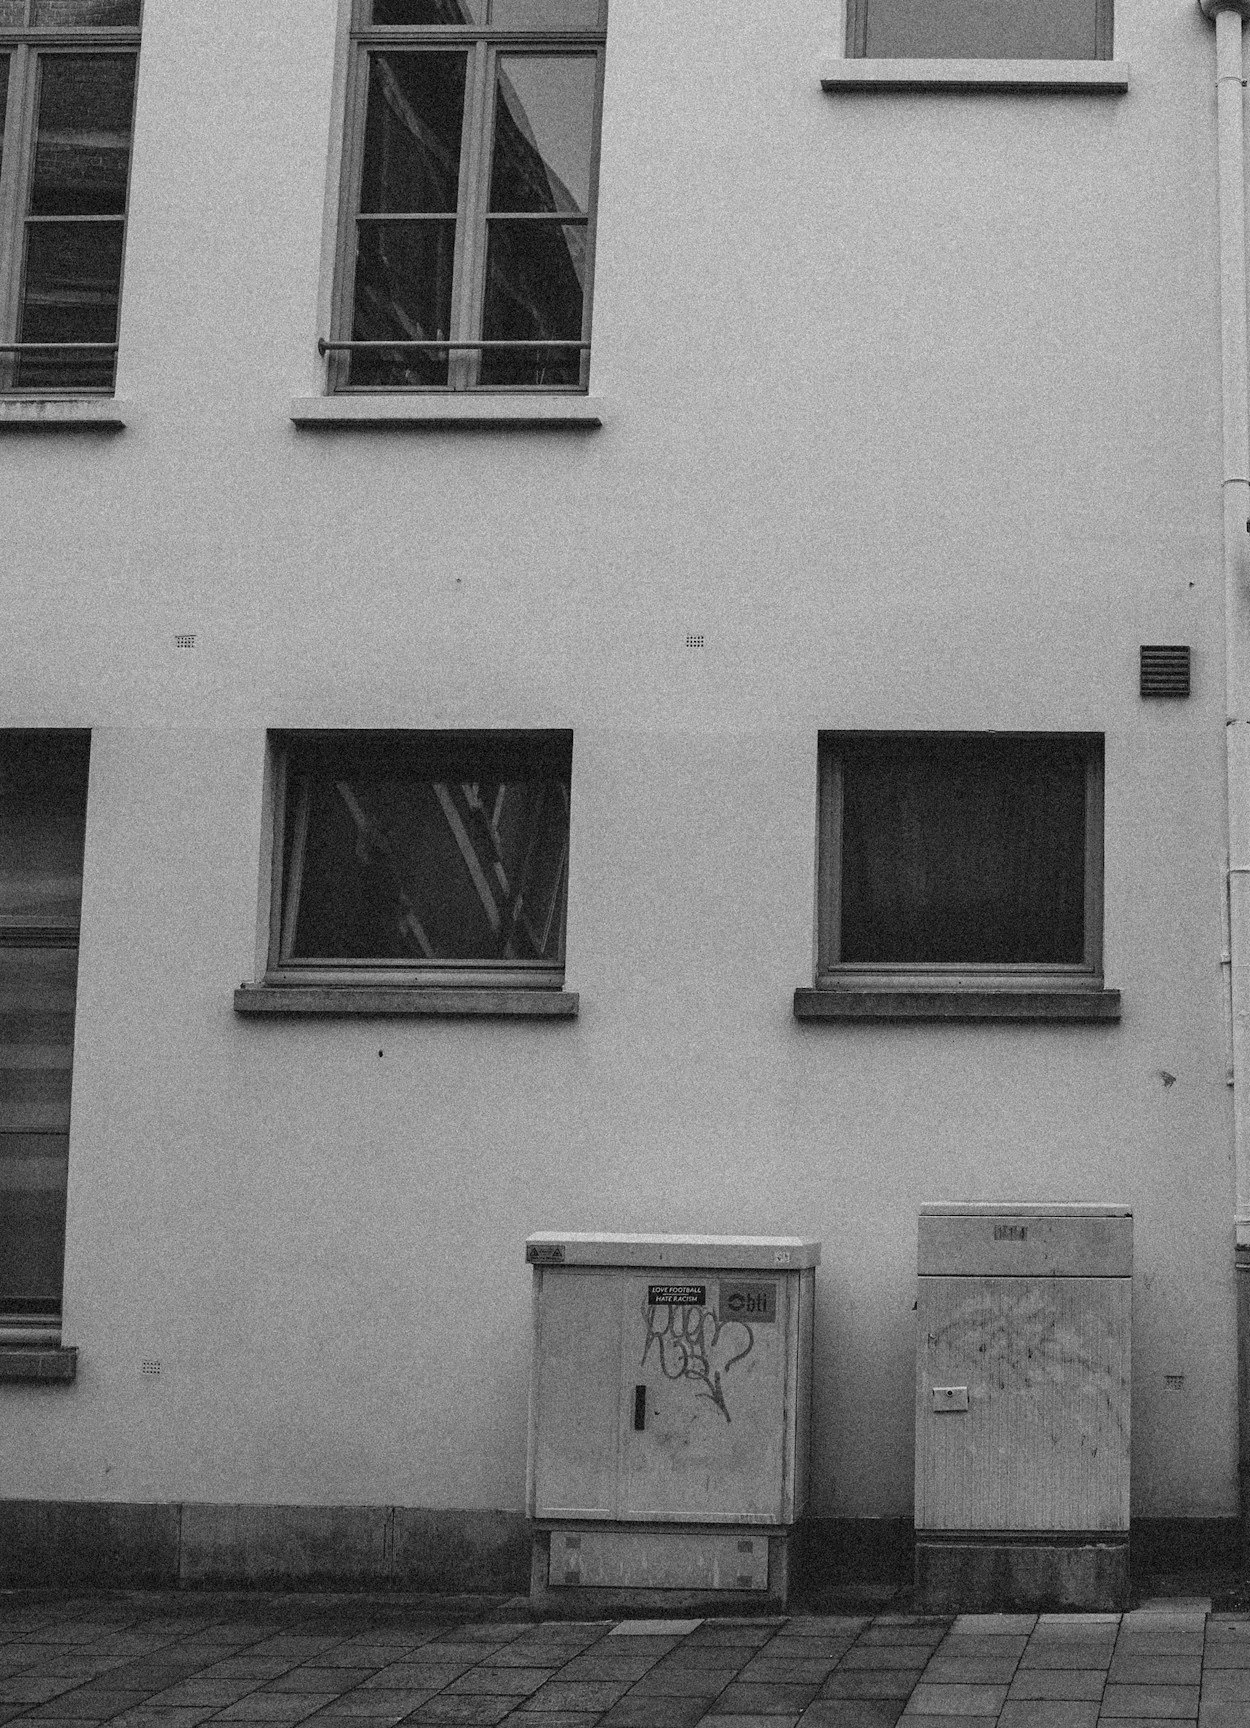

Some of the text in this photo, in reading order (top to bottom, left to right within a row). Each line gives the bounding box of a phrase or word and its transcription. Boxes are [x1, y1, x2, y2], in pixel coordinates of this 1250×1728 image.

[652, 1286, 702, 1294] LOVE FOOTBALL
[655, 1295, 698, 1303] HATE RACISM
